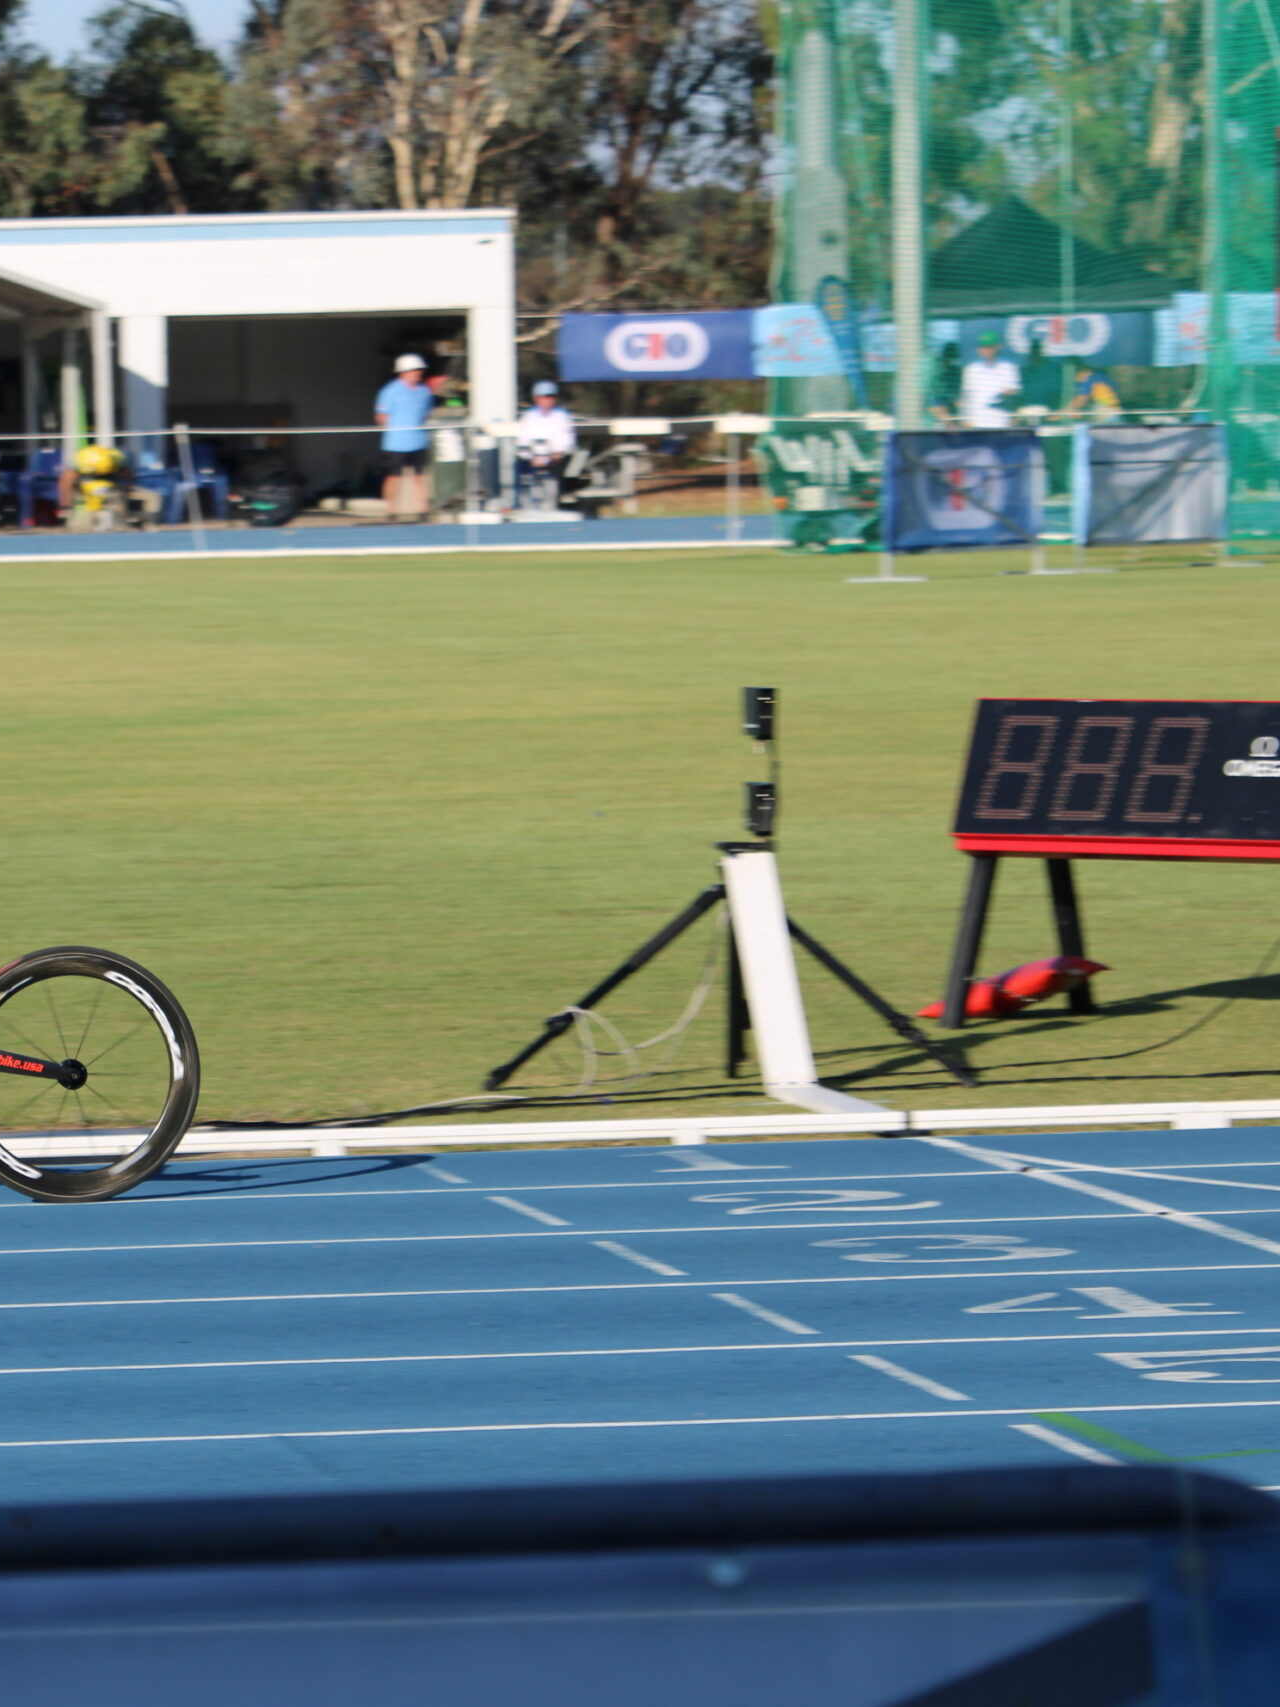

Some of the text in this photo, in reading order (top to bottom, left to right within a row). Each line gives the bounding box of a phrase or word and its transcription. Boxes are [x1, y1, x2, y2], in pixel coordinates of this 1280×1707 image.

[623, 332, 690, 361] GIO
[689, 1189, 942, 1215] 2
[809, 1233, 1078, 1264] 3
[962, 1286, 1245, 1320] 4
